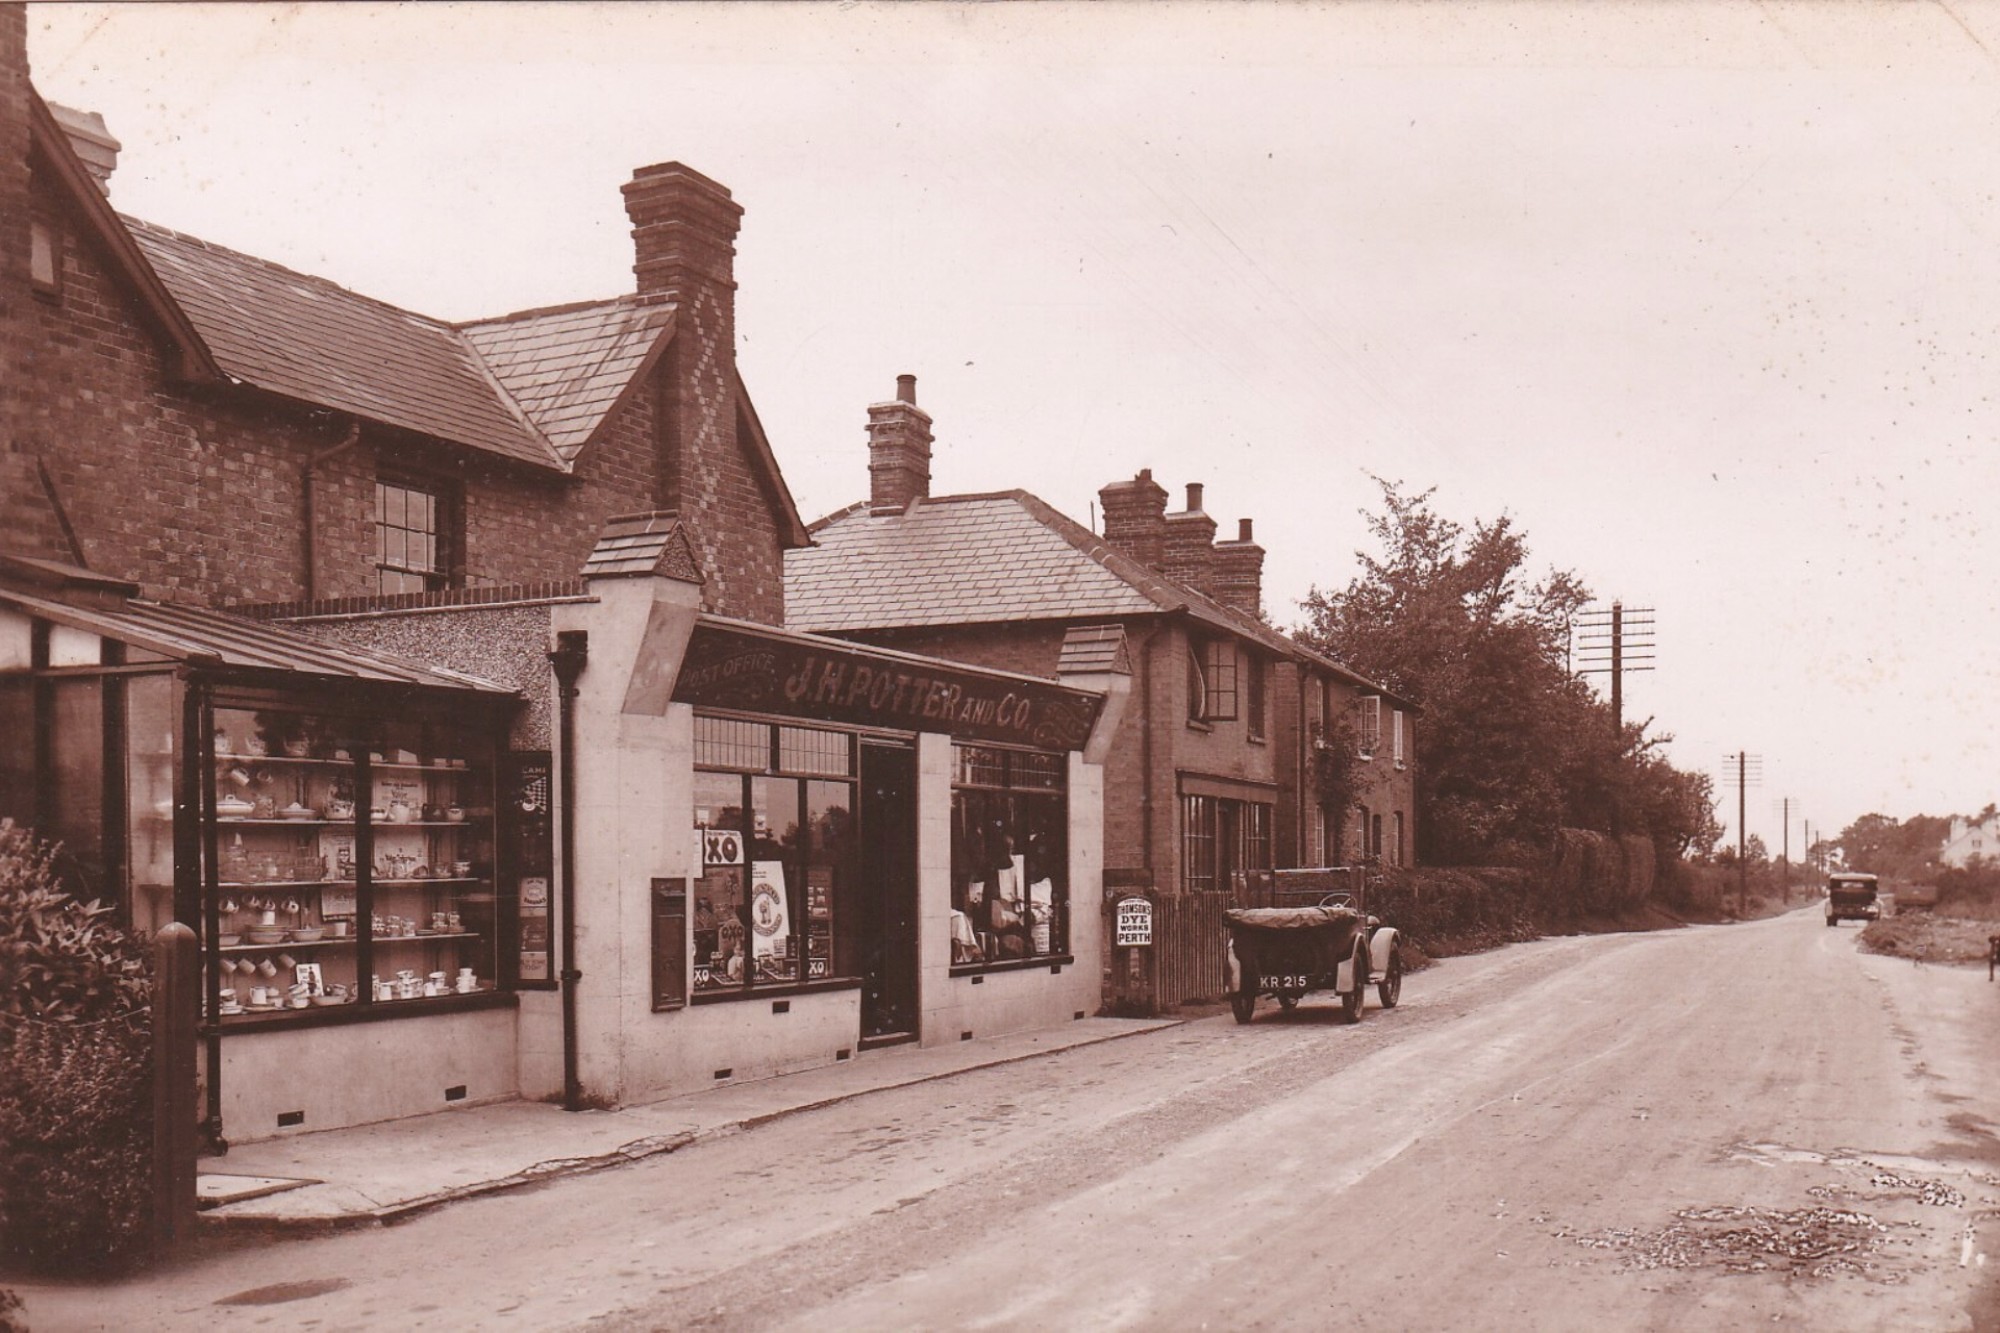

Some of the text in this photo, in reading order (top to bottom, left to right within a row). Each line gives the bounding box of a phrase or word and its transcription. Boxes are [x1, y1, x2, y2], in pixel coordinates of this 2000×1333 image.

[723, 652, 775, 677] OFFICE
[959, 697, 995, 726] AND
[707, 836, 737, 863] XO
[1121, 915, 1148, 924] DYE
[1118, 933, 1150, 943] PERTH
[808, 961, 825, 975] XO
[694, 969, 710, 982] XO
[1260, 976, 1307, 988] KR 215
